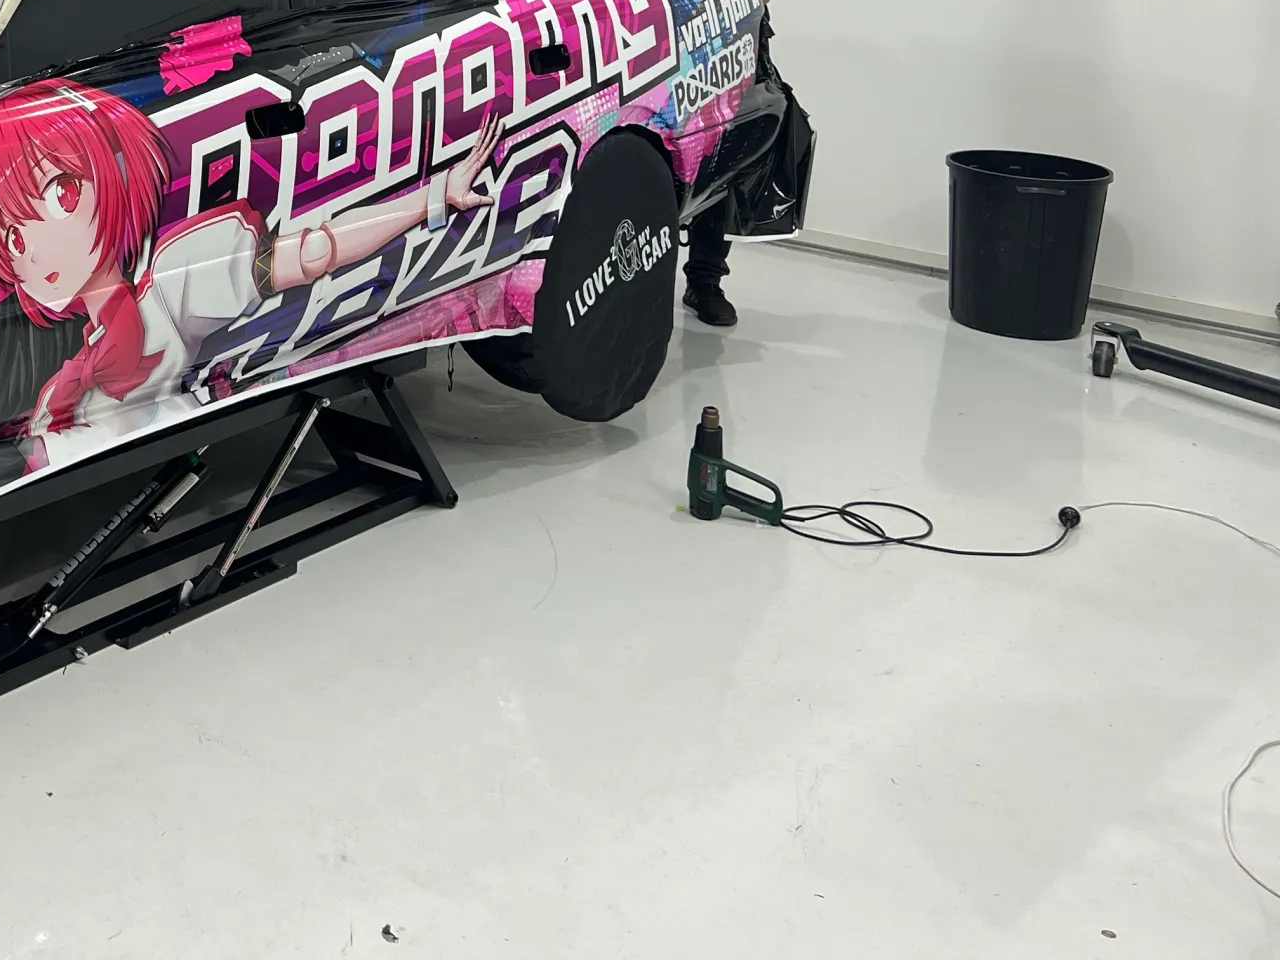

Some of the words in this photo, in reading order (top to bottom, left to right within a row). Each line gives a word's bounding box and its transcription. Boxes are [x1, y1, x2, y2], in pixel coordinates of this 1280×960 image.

[674, 44, 743, 117] POLARIS
[638, 225, 650, 248] MY
[641, 225, 671, 272] CAR
[575, 256, 615, 316] LOVE
[566, 300, 575, 327] I
